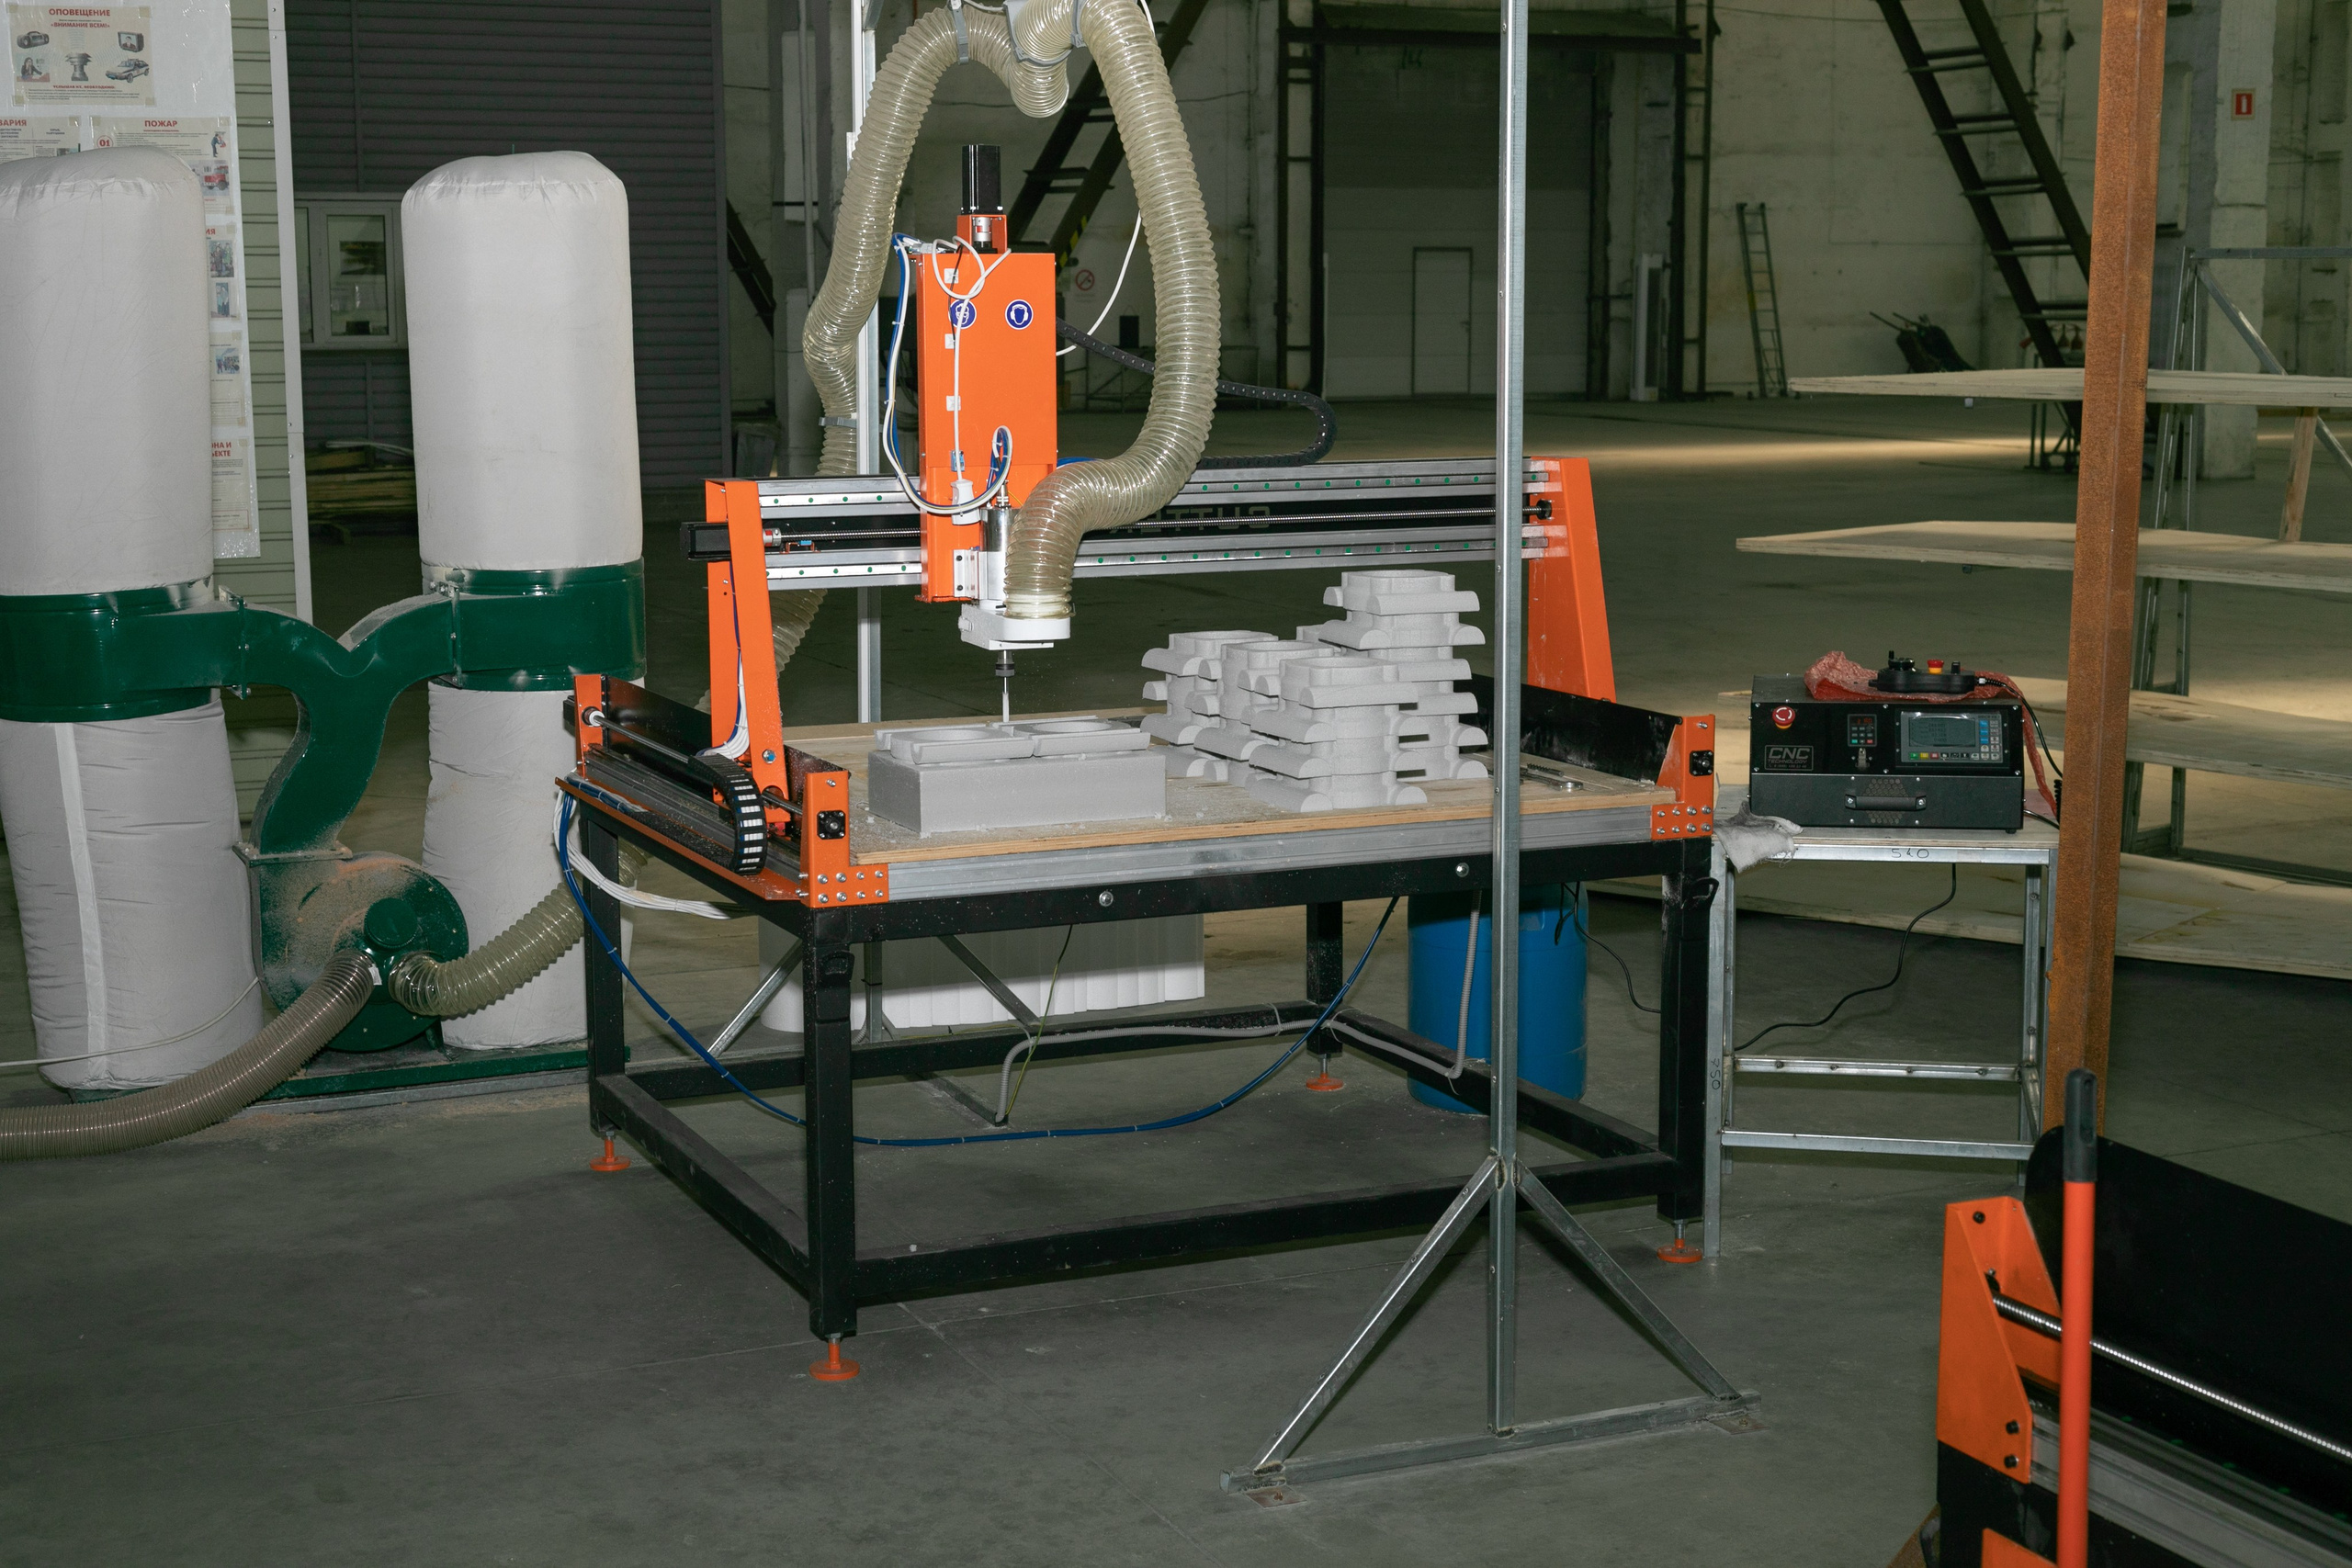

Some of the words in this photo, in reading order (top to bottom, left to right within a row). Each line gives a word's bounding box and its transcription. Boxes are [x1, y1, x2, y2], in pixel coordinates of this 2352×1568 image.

[49, 8, 110, 17] ОПОВЕЩЕНИЕ
[1769, 747, 1810, 760] CNC
[1710, 1057, 1721, 1090] 750
